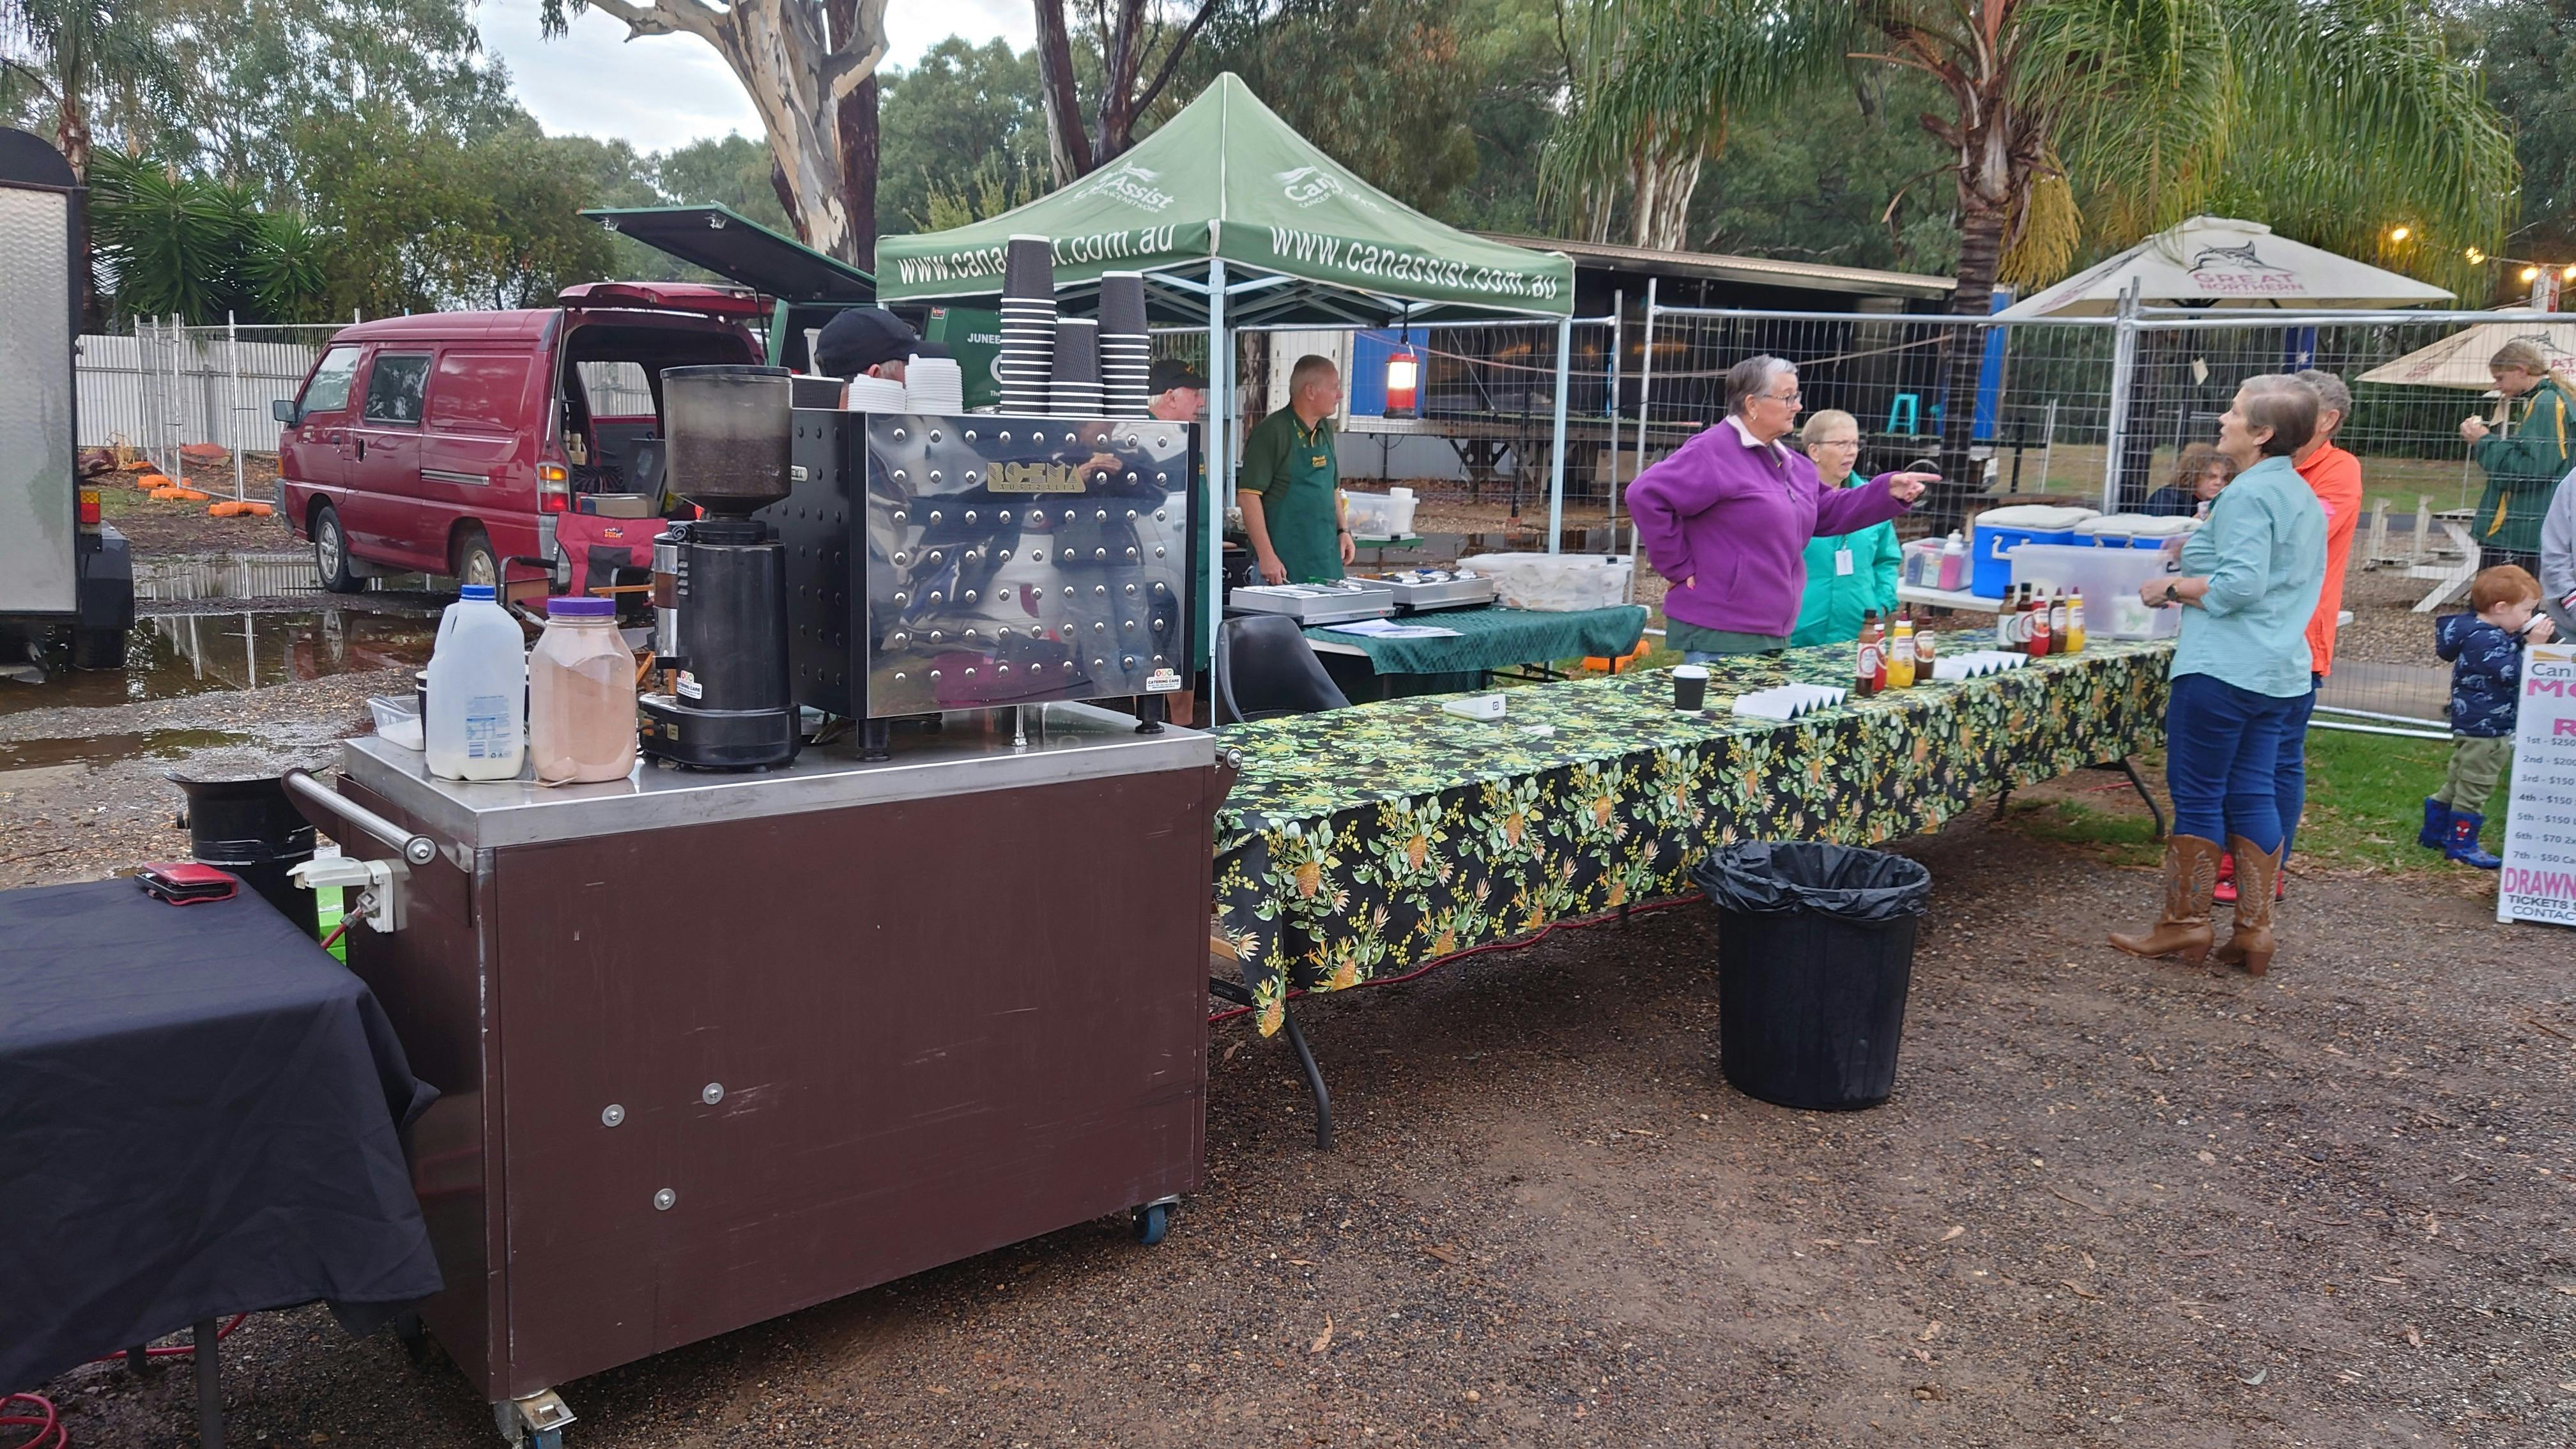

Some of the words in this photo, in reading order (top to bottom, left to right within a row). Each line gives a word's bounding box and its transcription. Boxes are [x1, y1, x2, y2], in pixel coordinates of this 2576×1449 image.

[1269, 226, 1557, 300] www.canassist.com.au
[2193, 274, 2292, 282] GREAT
[2526, 736, 2540, 744] 1st
[2523, 755, 2543, 763] 2nd
[2520, 774, 2539, 783] 3rd
[2549, 776, 2575, 786] $150
[2547, 795, 2572, 805] $150
[2517, 813, 2534, 821] 5th
[2545, 815, 2570, 824] $150
[2515, 832, 2532, 840] 6th
[2543, 834, 2561, 843] $70
[2513, 851, 2530, 859] 7th
[2540, 854, 2559, 862] $50
[2563, 856, 2576, 864] Ca
[2504, 867, 2576, 900] DRAWN
[2508, 894, 2568, 910] TICKETS
